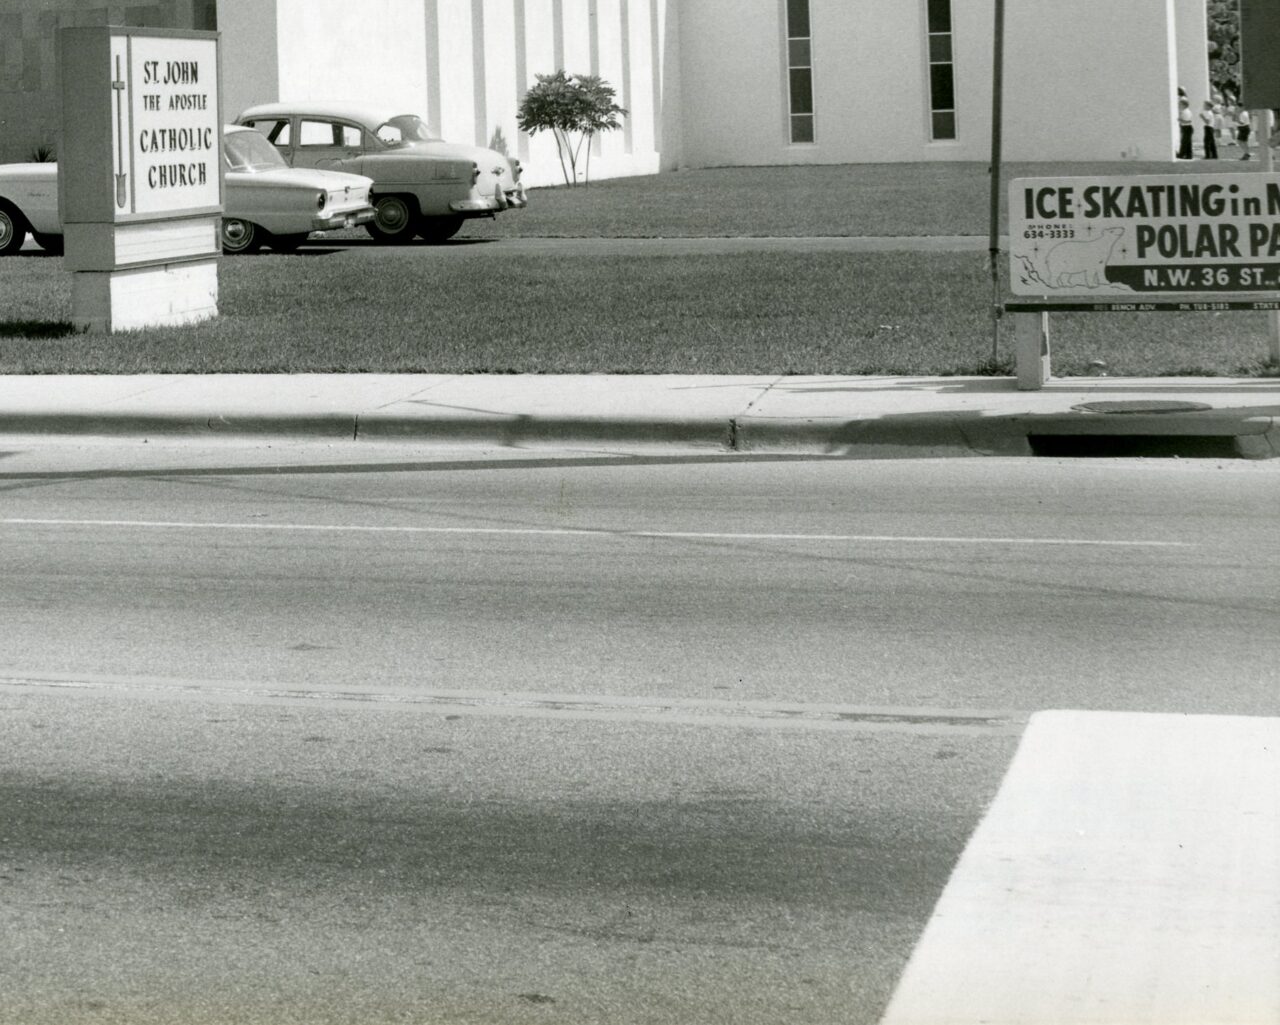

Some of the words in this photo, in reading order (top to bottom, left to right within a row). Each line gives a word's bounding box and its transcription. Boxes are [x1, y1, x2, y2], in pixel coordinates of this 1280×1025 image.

[144, 61, 160, 84] ST.
[163, 61, 199, 84] JOHN
[143, 94, 161, 110] THE
[168, 94, 208, 110] APOSTLE
[139, 128, 212, 153] CATHOLIC
[148, 162, 207, 189] CHURCH
[1024, 187, 1075, 219] ICE
[1083, 184, 1226, 218] SKATING
[1228, 183, 1262, 216] in
[1024, 230, 1075, 239] 634-3333
[1136, 223, 1242, 259] POLAR
[1144, 269, 1196, 287] N.W.
[1201, 267, 1230, 286] 36
